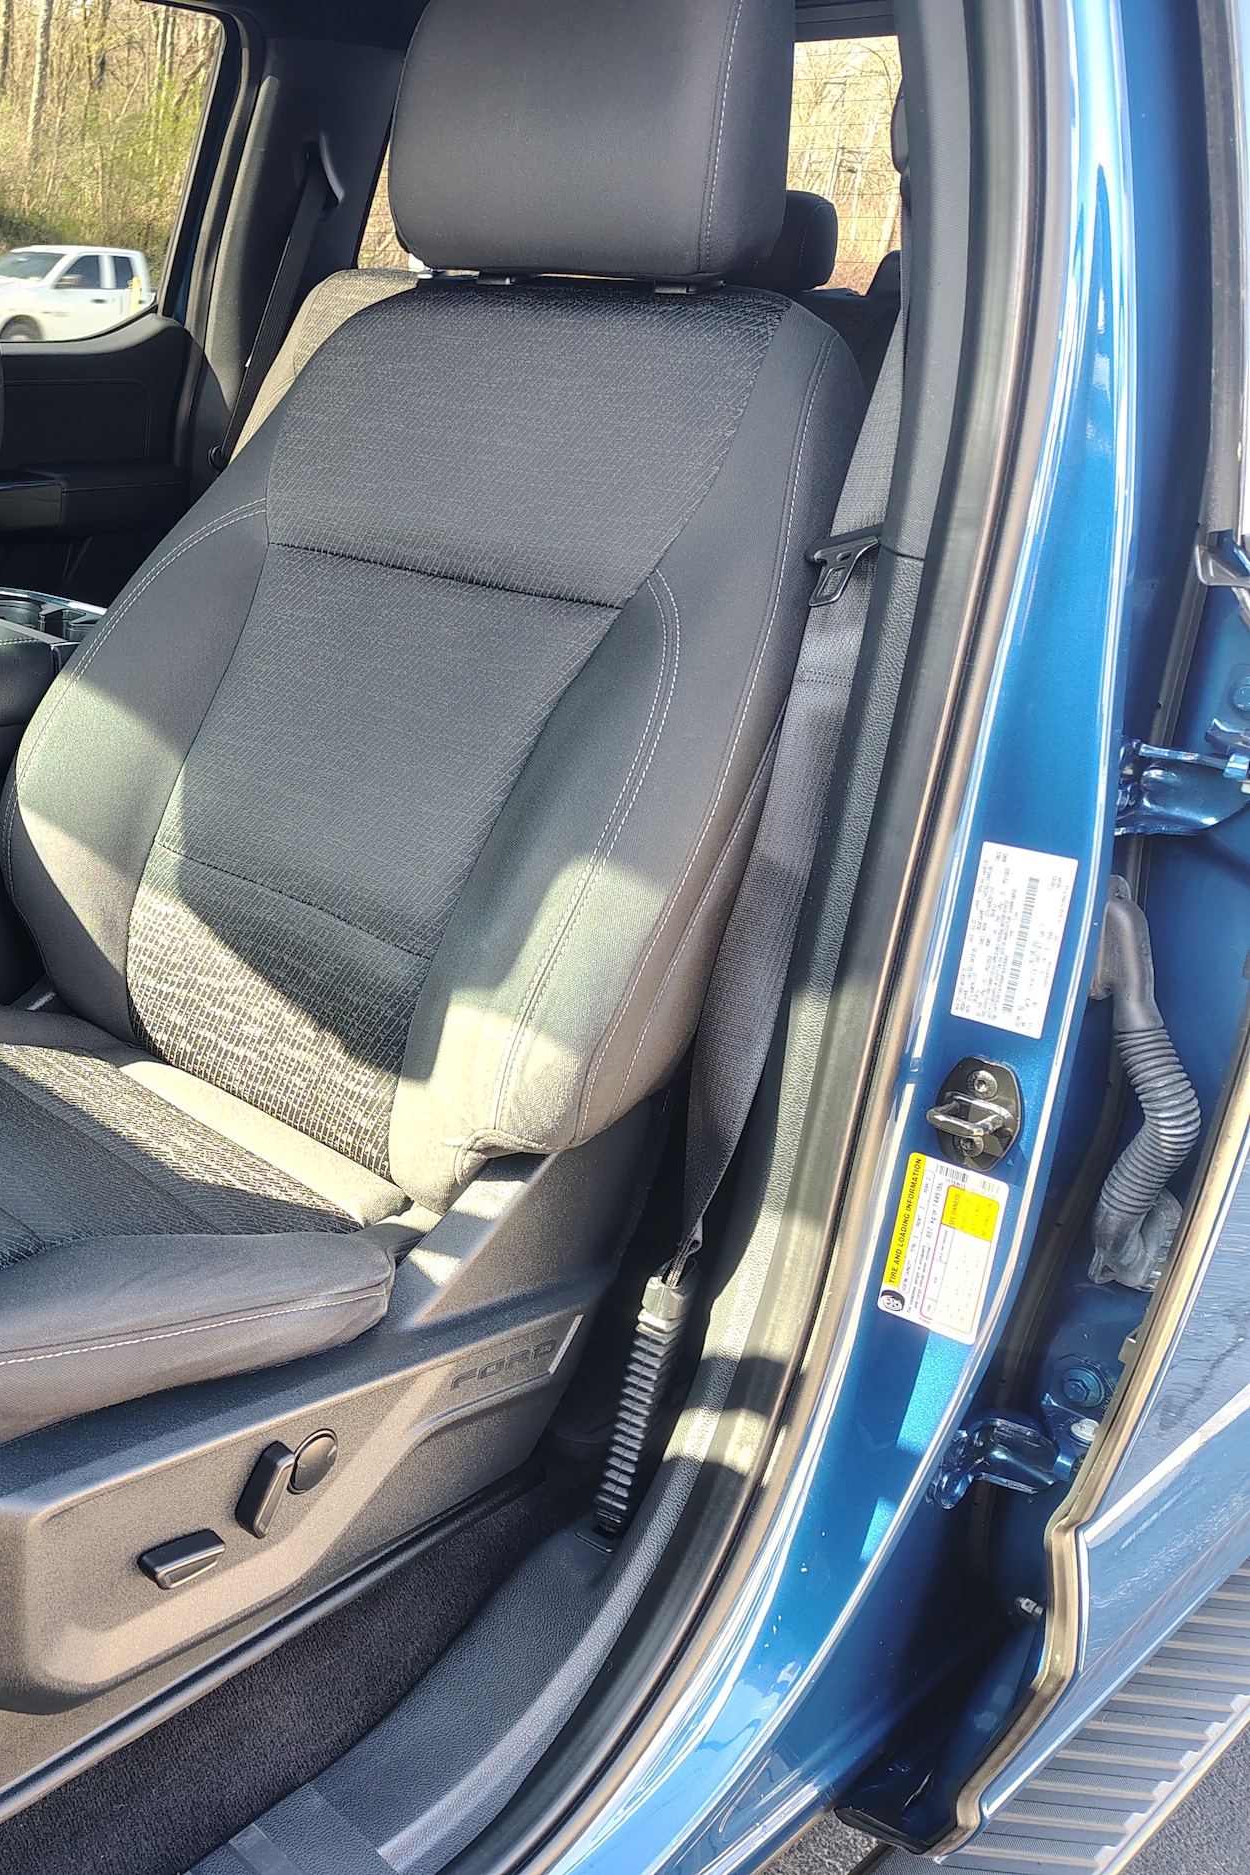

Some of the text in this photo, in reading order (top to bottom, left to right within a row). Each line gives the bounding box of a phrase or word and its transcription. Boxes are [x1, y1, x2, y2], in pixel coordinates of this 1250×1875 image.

[889, 1158, 922, 1284] TIRE AND LOADING INFORMATION
[451, 1340, 556, 1389] FORD
